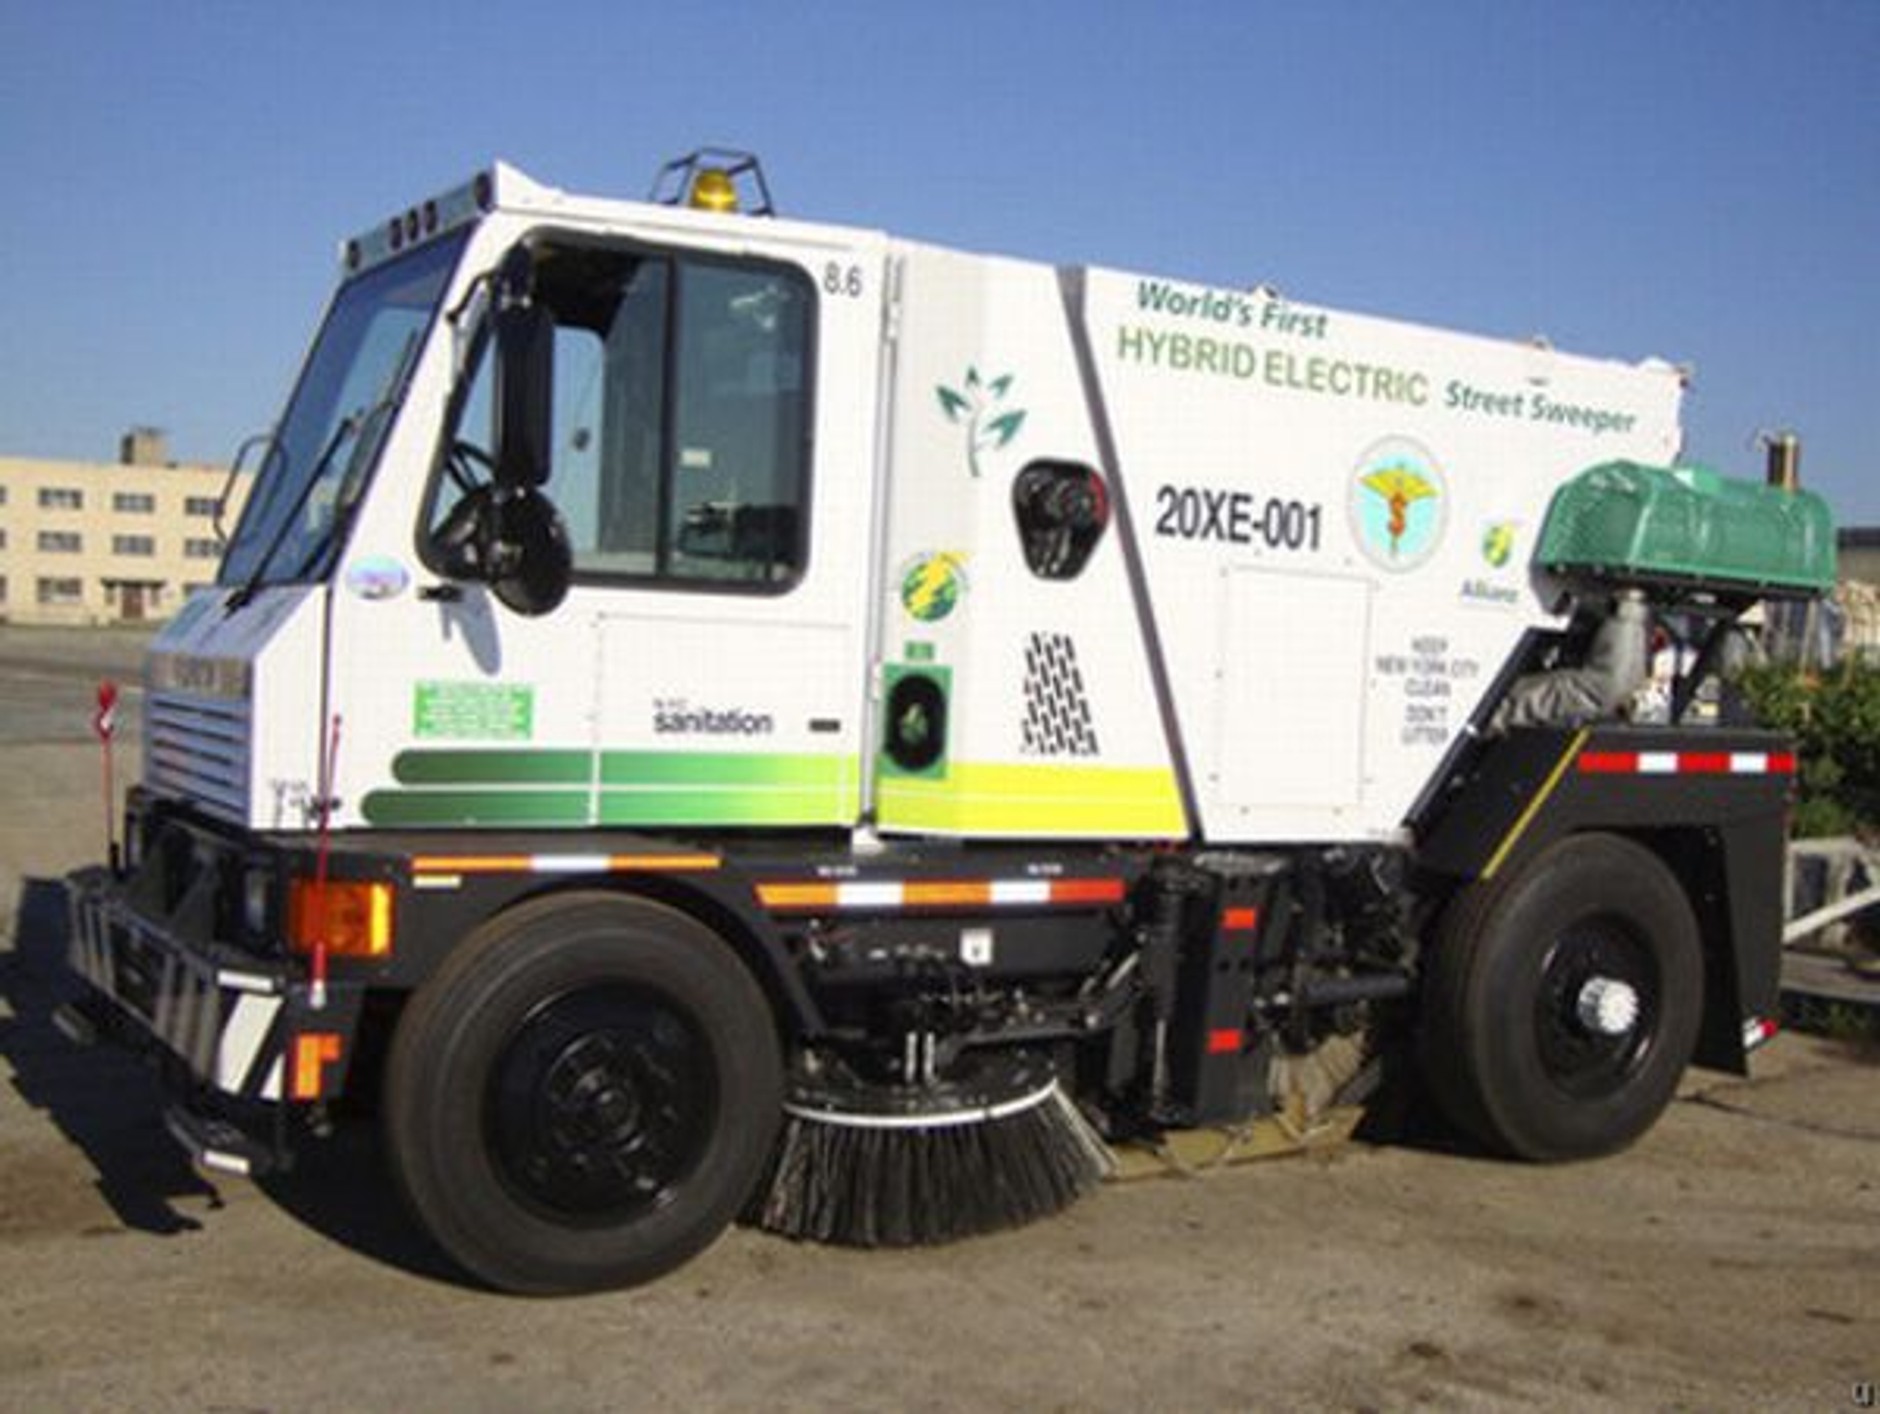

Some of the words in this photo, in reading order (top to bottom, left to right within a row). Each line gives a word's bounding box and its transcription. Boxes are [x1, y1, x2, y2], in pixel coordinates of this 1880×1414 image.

[823, 260, 864, 299] 8.6
[1138, 280, 1253, 327] World's
[1260, 299, 1329, 340] First
[1118, 325, 1255, 378] HYBRID
[1263, 350, 1430, 406] ELECTRIC
[1443, 379, 1524, 419] Street
[1530, 393, 1638, 436] Sweeper
[1155, 484, 1322, 552] 20XE-001
[653, 707, 773, 736] sanitation
